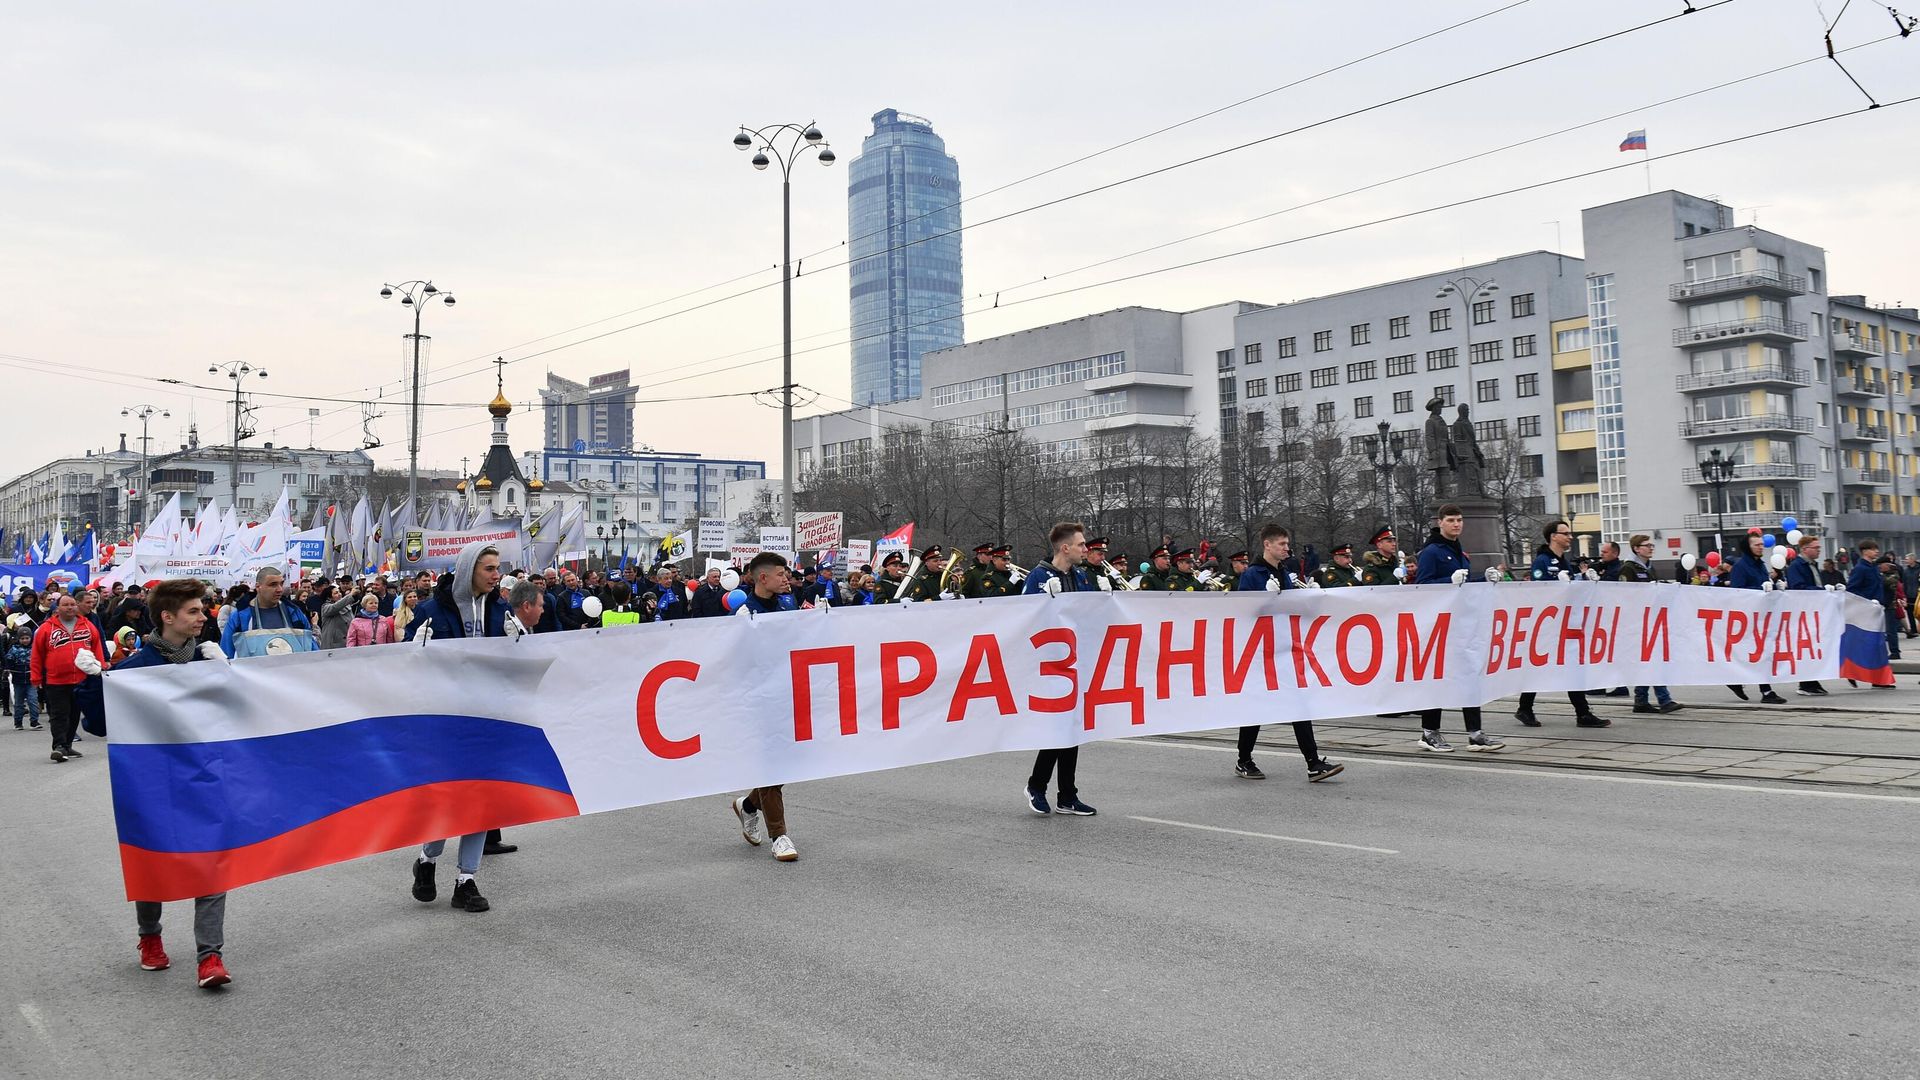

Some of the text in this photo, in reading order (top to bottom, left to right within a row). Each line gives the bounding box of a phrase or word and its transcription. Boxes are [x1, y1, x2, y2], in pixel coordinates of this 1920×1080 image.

[797, 513, 839, 534] Защитим
[805, 523, 835, 539] права
[800, 525, 841, 549] человека!
[636, 606, 1822, 760] С ПРАЗДНИКОМ ВЕСНЫ И ТРУДА!
